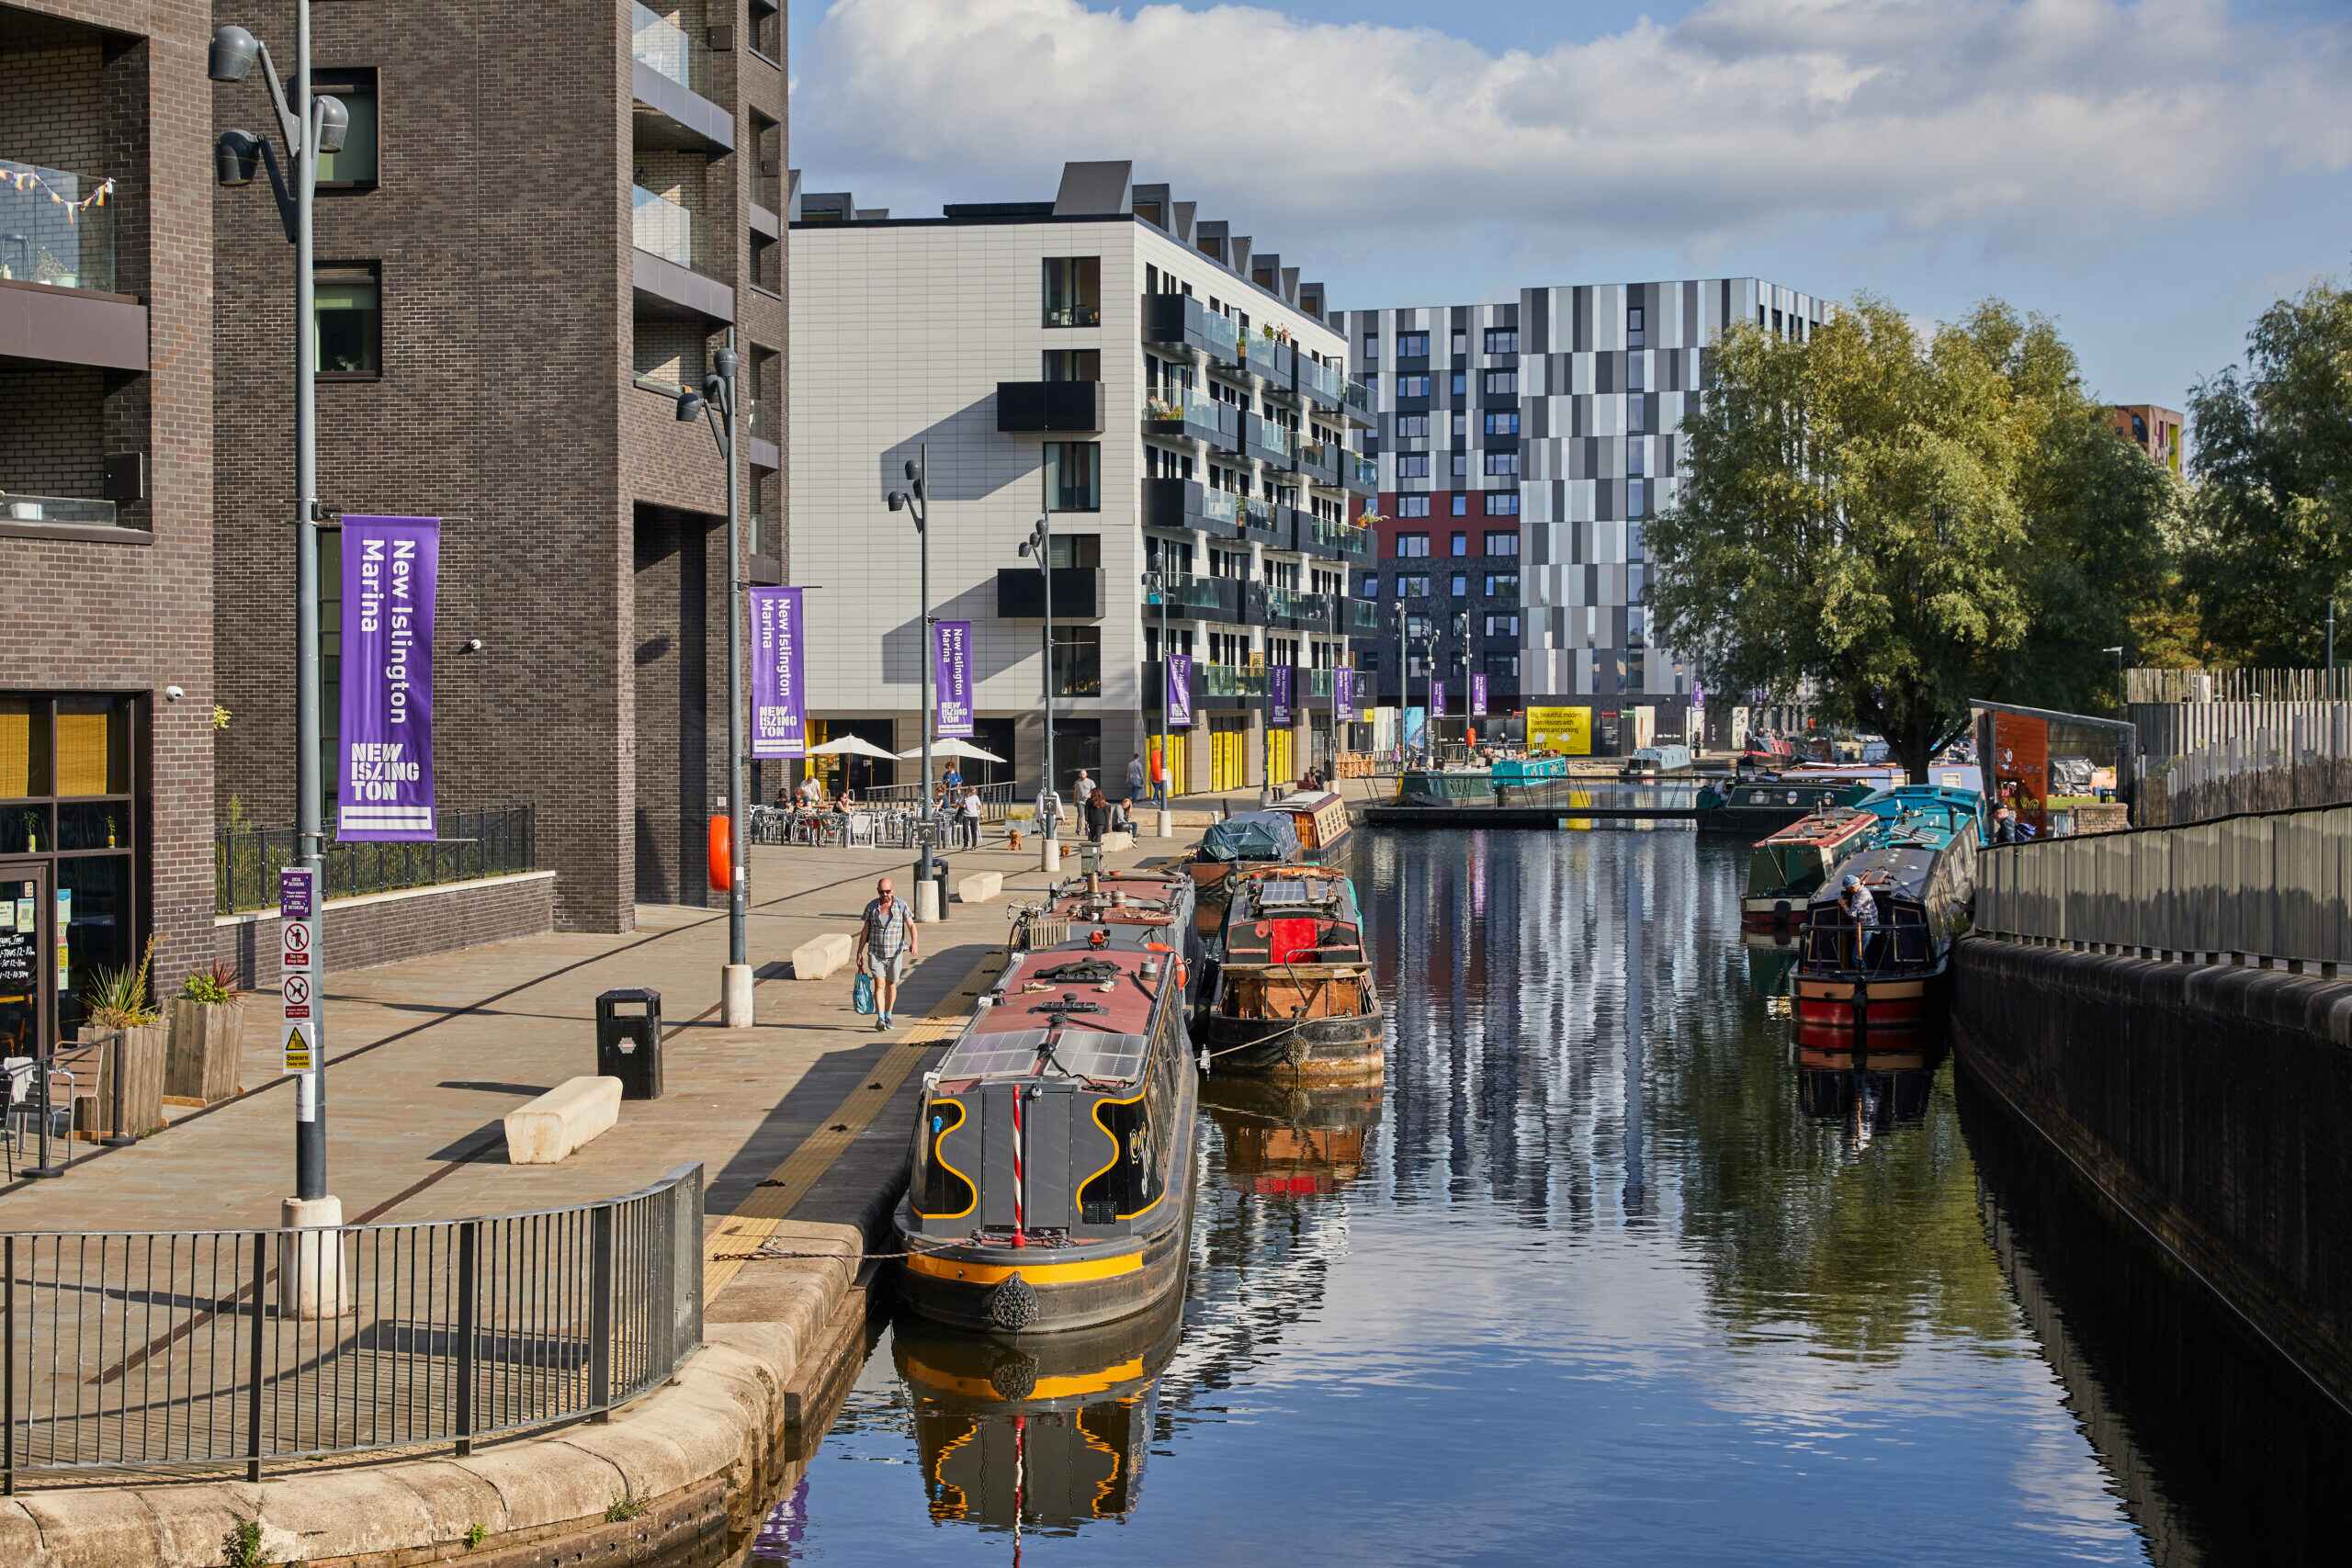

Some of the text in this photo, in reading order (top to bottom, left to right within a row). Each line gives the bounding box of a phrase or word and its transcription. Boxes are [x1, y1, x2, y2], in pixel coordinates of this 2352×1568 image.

[361, 539, 385, 632] Marina
[385, 539, 416, 724] New Islington
[761, 598, 774, 649] Marina
[776, 598, 792, 696] New Islington
[942, 628, 951, 663] Marina
[953, 628, 964, 696] New Islington
[759, 706, 788, 716] NEW
[759, 726, 785, 737] TON
[351, 743, 403, 762] NEW
[351, 781, 397, 801] TON
